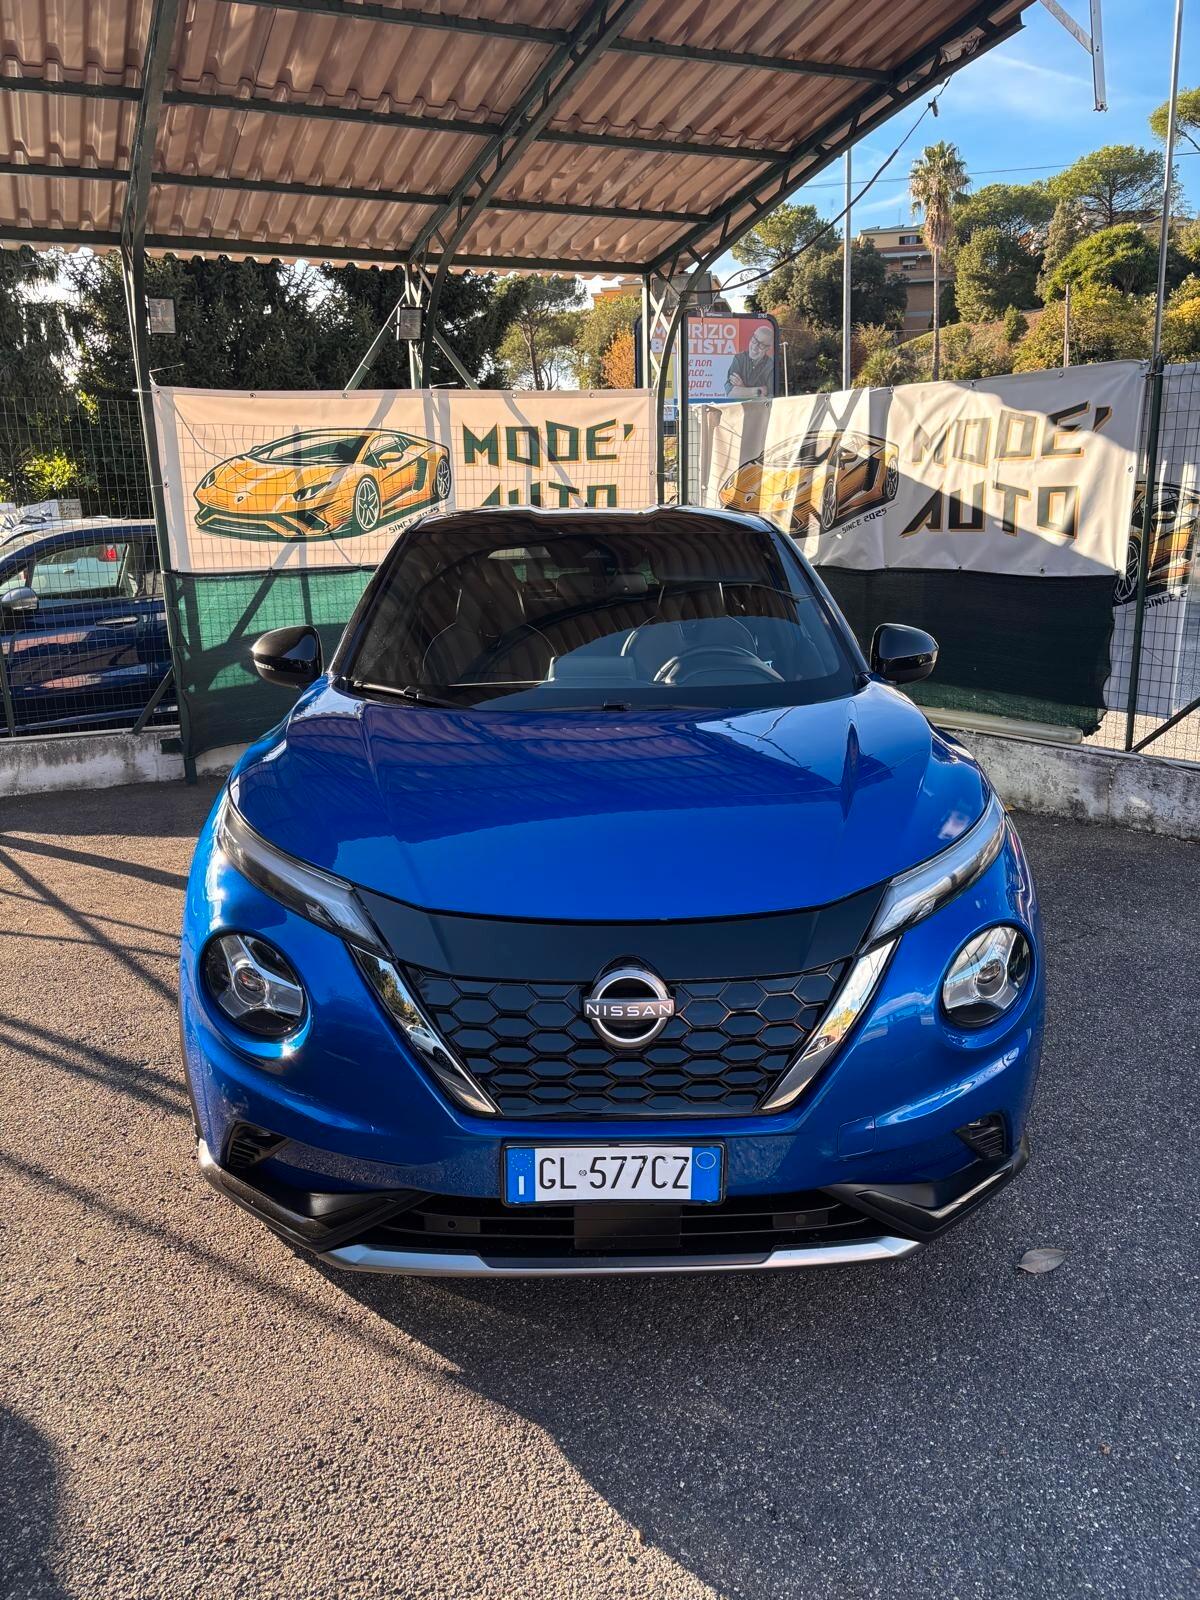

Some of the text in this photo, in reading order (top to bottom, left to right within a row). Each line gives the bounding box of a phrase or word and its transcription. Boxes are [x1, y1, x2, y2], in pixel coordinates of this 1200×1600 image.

[695, 359, 712, 367] non
[841, 507, 888, 534] SINCE 2025
[899, 480, 1080, 539] AUTO
[1144, 593, 1177, 610] SINCE
[586, 1003, 673, 1017] NISSAN
[539, 1157, 577, 1190] GL
[589, 1155, 691, 1190] 577CZ
